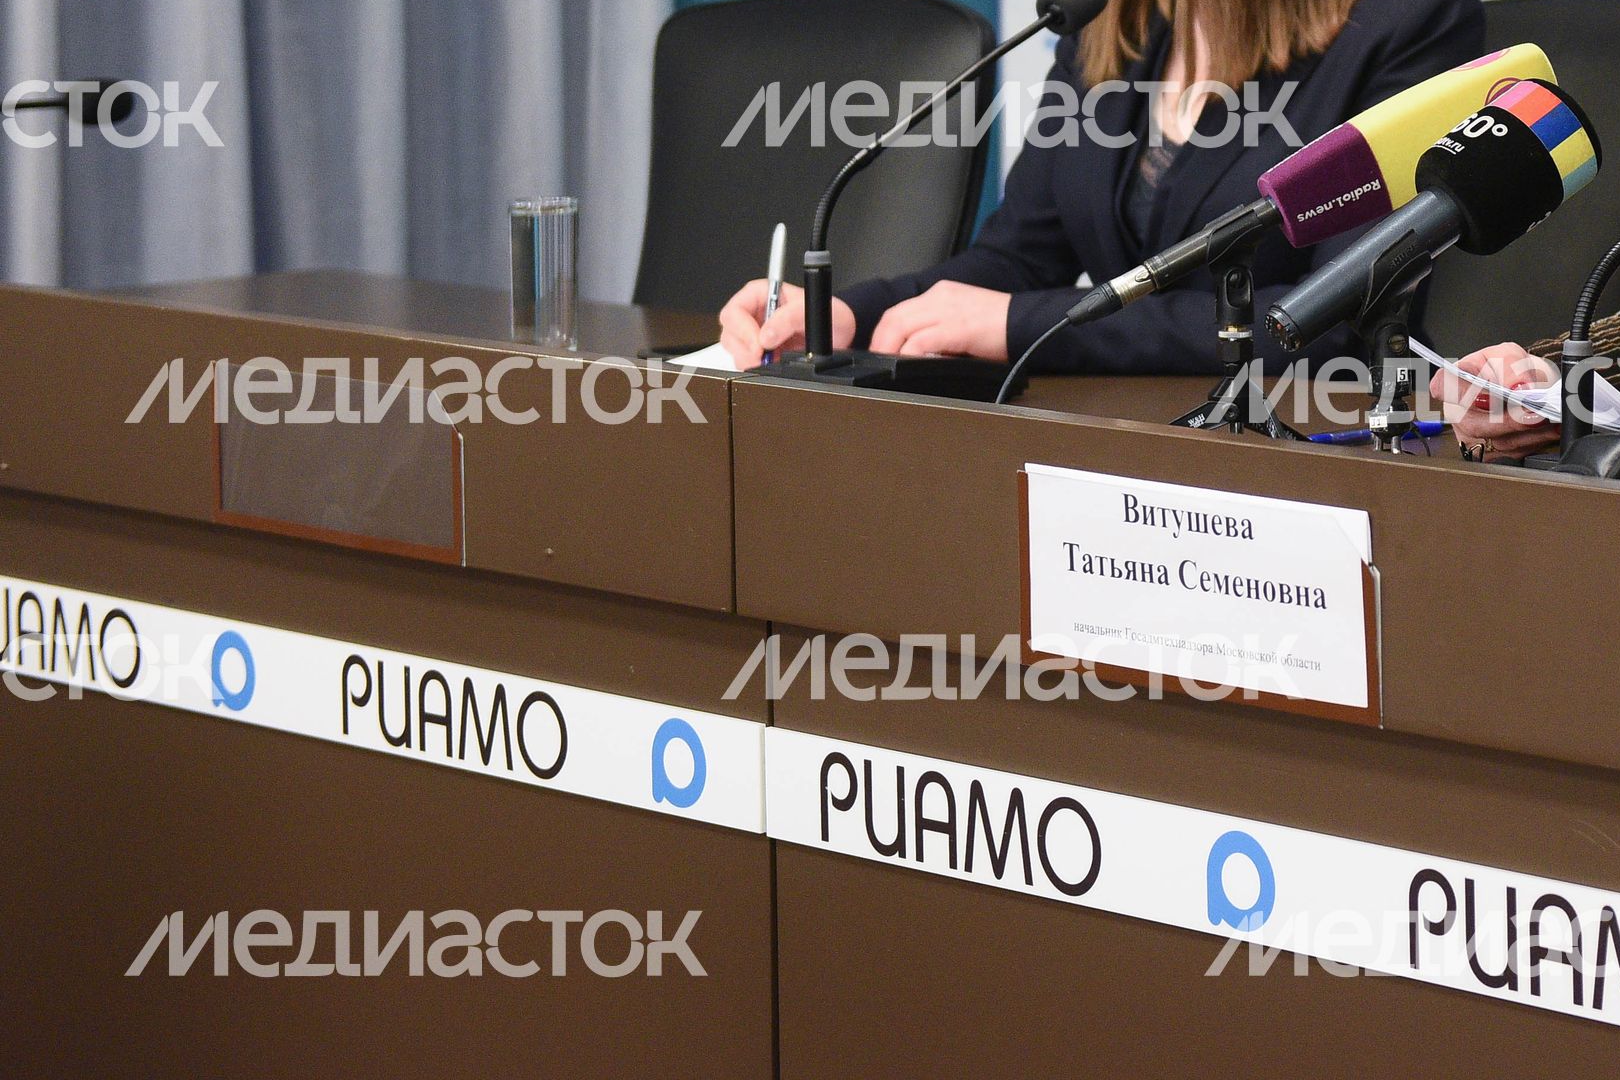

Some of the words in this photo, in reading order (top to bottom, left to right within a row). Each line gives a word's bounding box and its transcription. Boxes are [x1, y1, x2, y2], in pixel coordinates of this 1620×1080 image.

[1121, 492, 1256, 540] Витушева
[1062, 541, 1171, 587] Татьяна
[1178, 559, 1328, 610] Семеновна
[1073, 621, 1123, 640] начальник
[1280, 654, 1322, 671] области
[341, 652, 569, 780] РИАМО
[819, 750, 1103, 898] РИАМО
